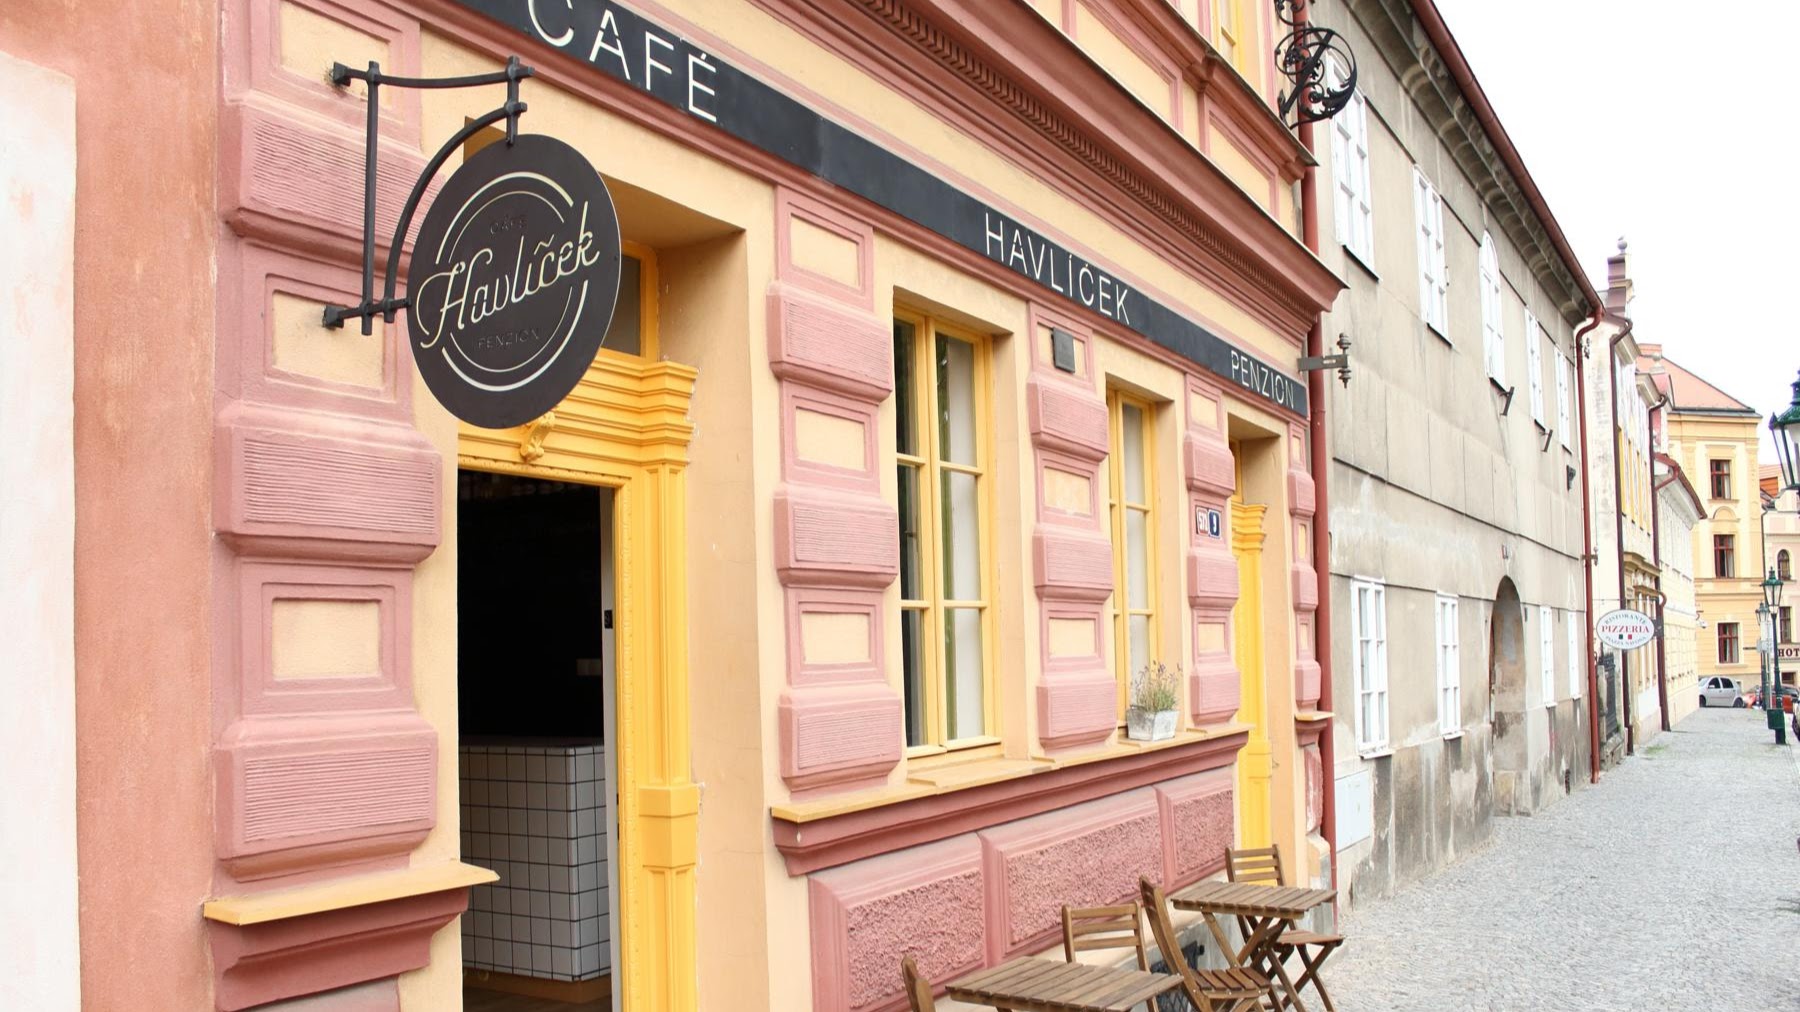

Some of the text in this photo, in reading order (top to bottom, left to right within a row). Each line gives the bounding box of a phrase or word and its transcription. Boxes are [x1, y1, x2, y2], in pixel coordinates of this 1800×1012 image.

[528, 0, 717, 123] CAFÉ
[1230, 350, 1295, 409] PENZION
[477, 328, 539, 349] PENZION
[1605, 613, 1646, 624] RISTORANTE
[1601, 625, 1650, 633] PIZZERIA
